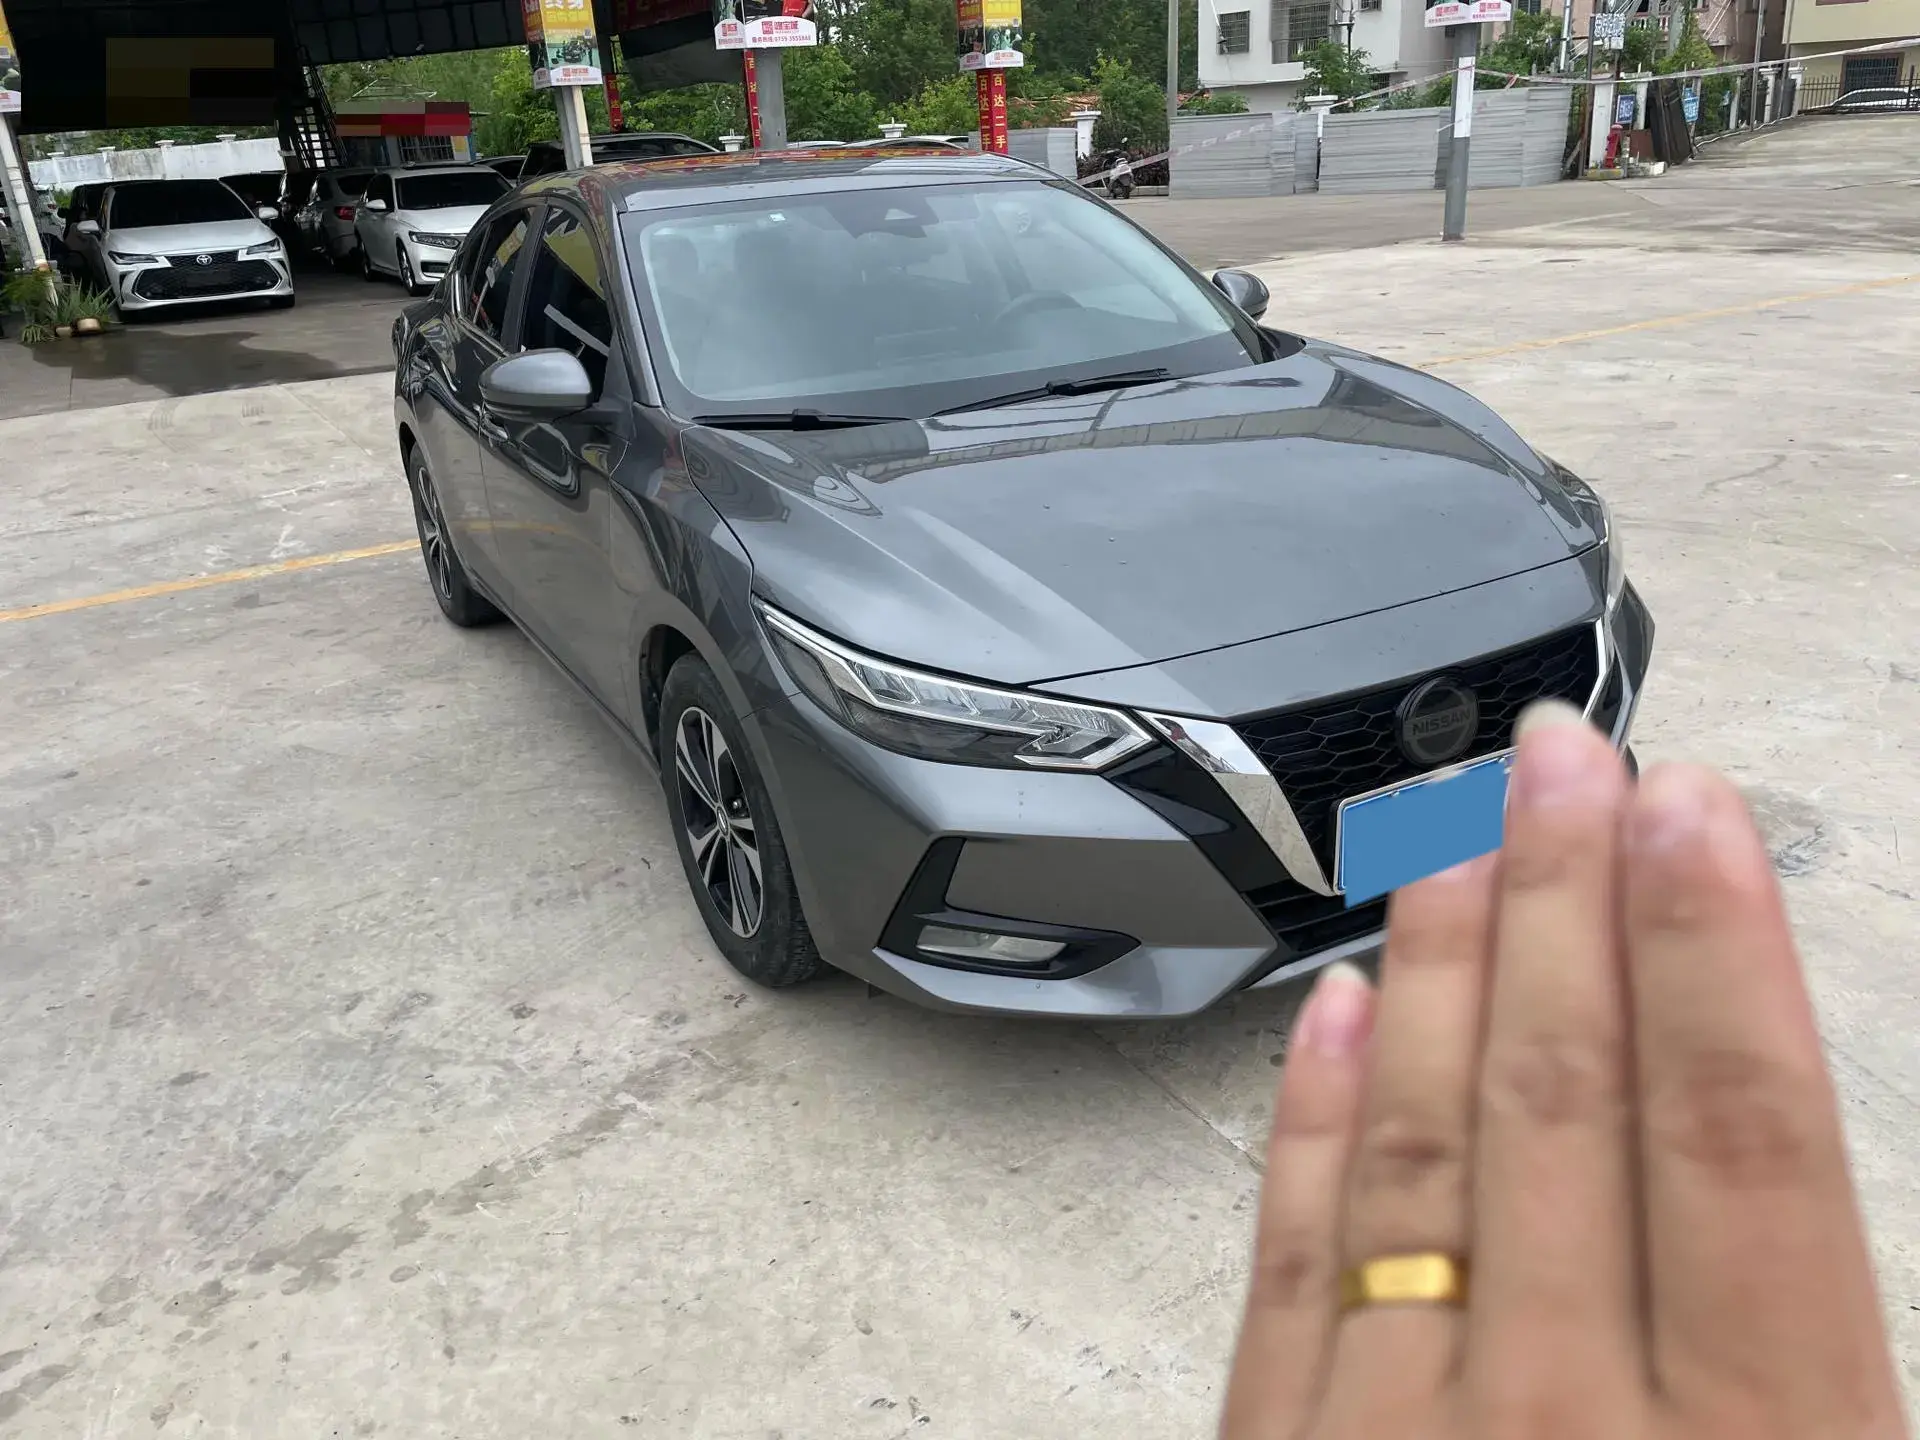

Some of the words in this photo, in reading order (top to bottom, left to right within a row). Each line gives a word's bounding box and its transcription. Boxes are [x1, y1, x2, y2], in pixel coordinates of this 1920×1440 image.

[979, 75, 991, 151] 百达二手
[993, 74, 1006, 148] 百达二手
[1412, 709, 1470, 735] NISSAN
